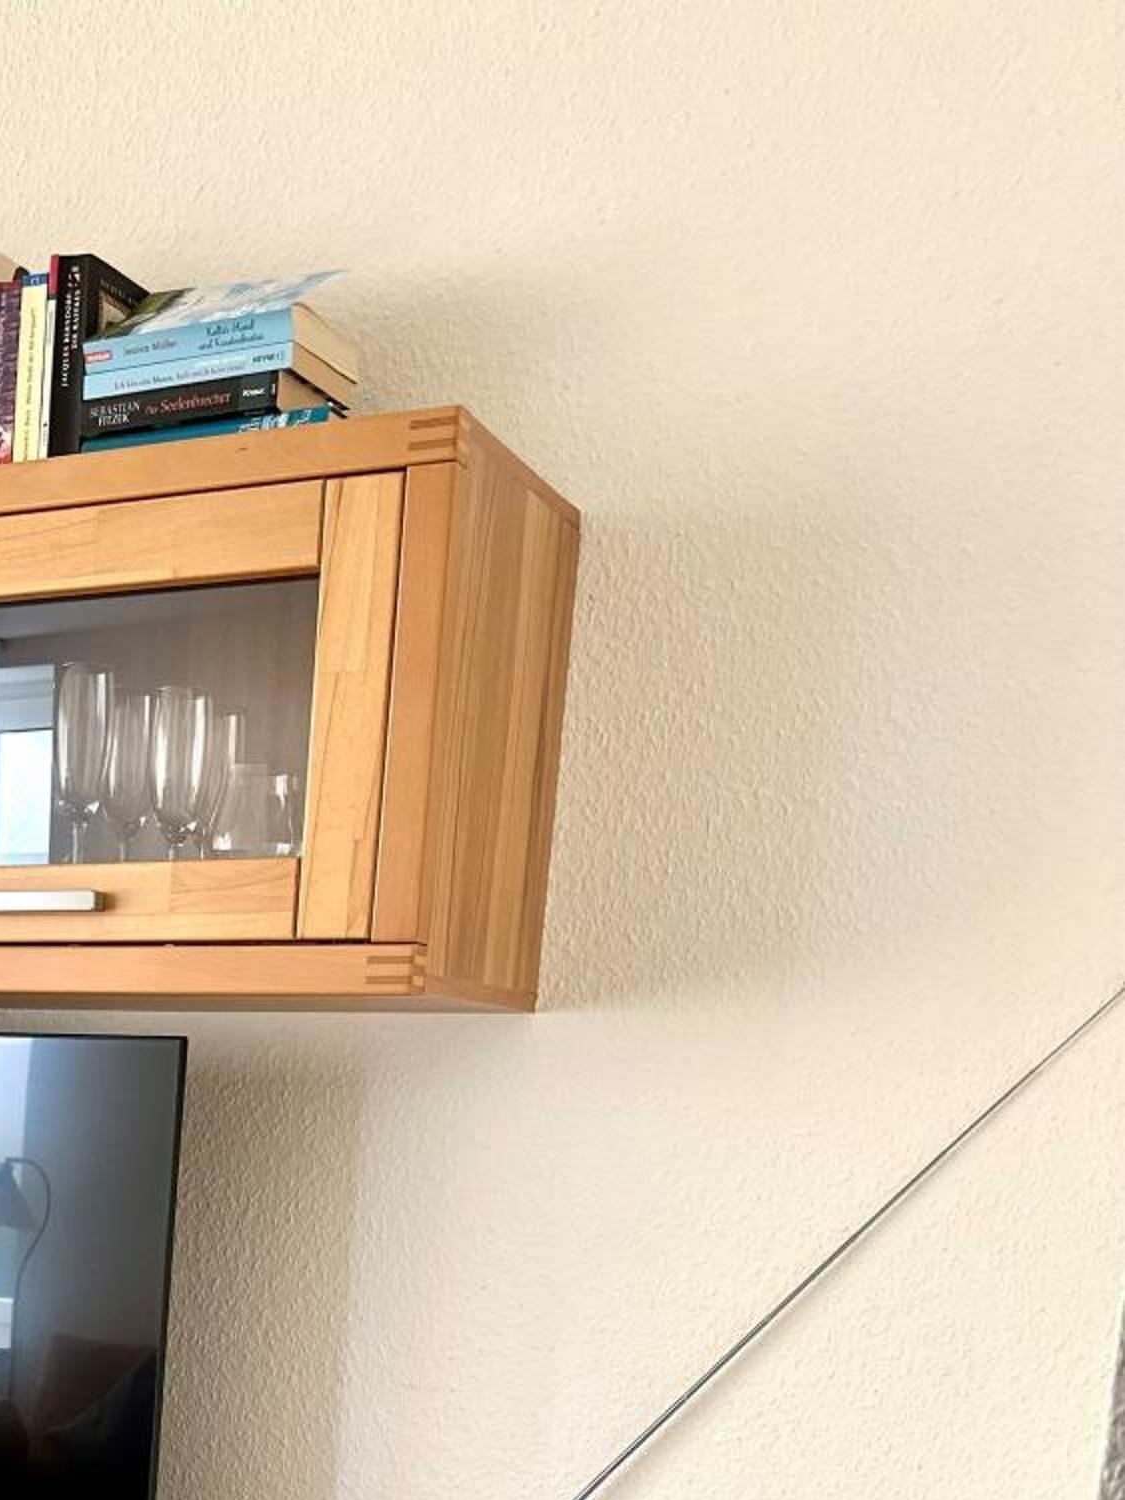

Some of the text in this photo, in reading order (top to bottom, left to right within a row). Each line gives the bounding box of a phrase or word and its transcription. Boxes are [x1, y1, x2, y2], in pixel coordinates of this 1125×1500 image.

[61, 346, 70, 387] JACQUES
[90, 400, 140, 417] SEBASTIAN
[98, 414, 130, 427] FITZEK
